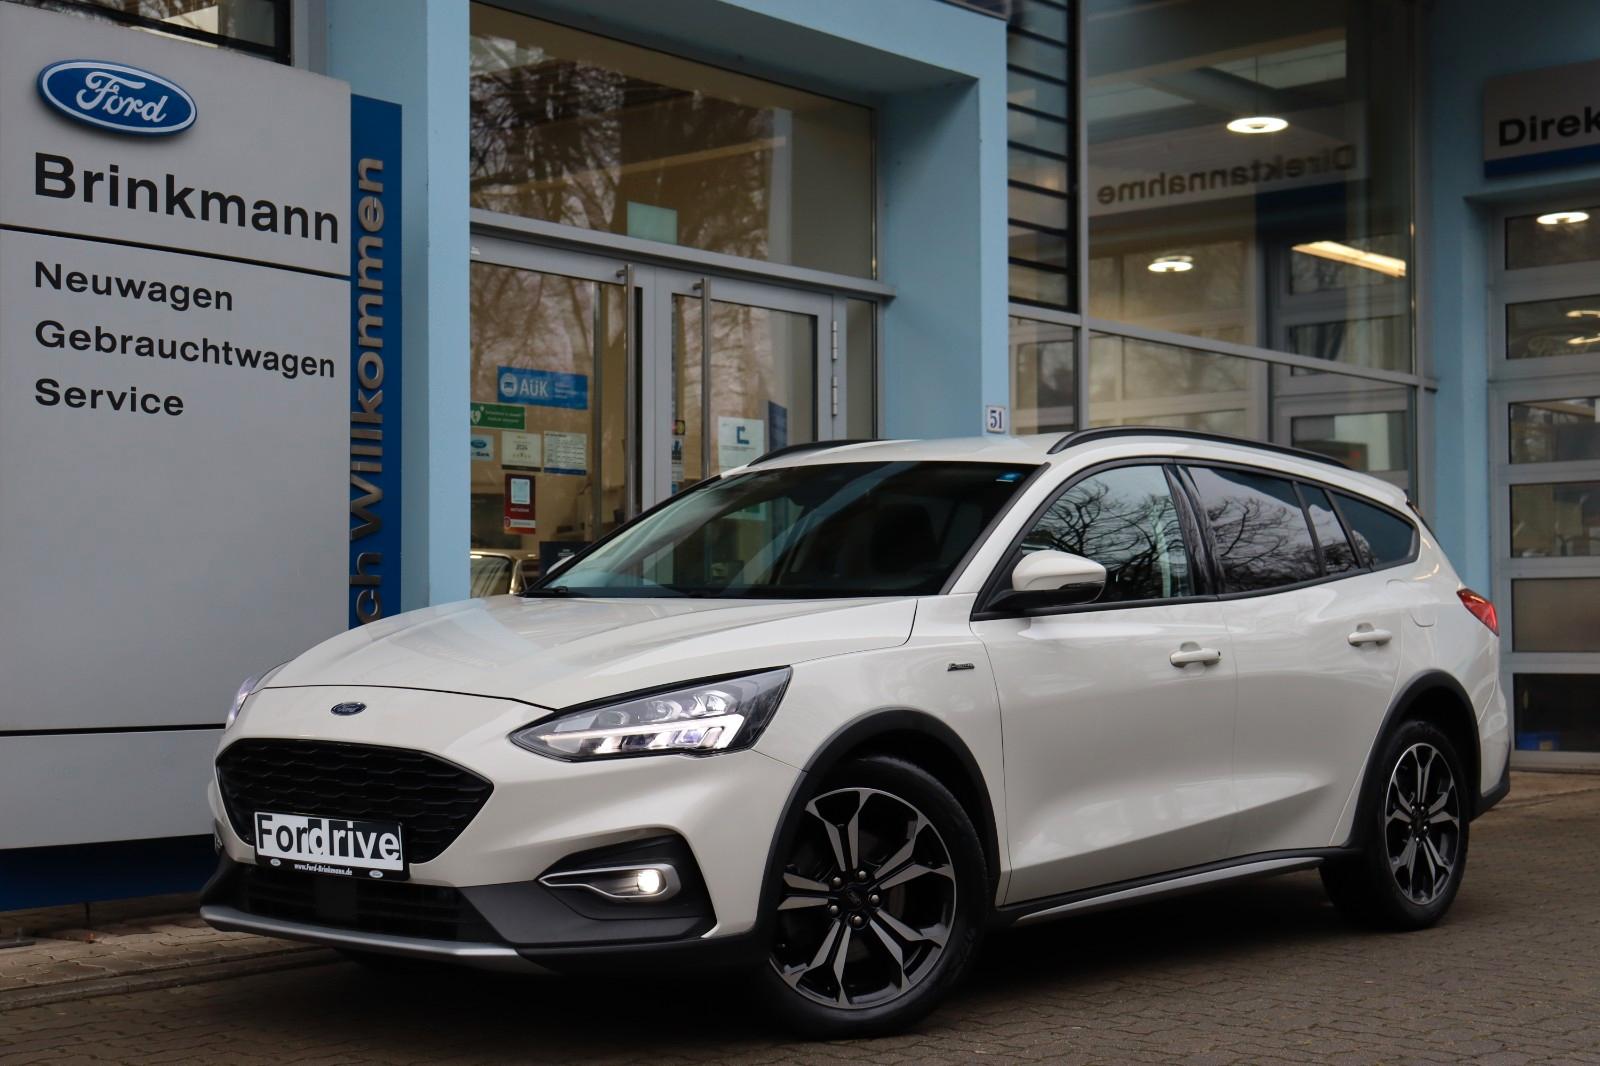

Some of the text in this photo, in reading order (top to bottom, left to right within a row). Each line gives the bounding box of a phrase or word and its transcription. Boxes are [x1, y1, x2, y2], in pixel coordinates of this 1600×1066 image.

[76, 71, 169, 123] Ford
[35, 152, 338, 244] Brinkmann
[35, 261, 233, 312] Neuwagen
[35, 320, 335, 379] Gebrauchtwagen
[350, 156, 384, 541] Willkommen
[35, 378, 184, 416] Service
[519, 378, 548, 397] AüK
[990, 410, 1002, 429] 51
[256, 815, 400, 860] Fordrive
